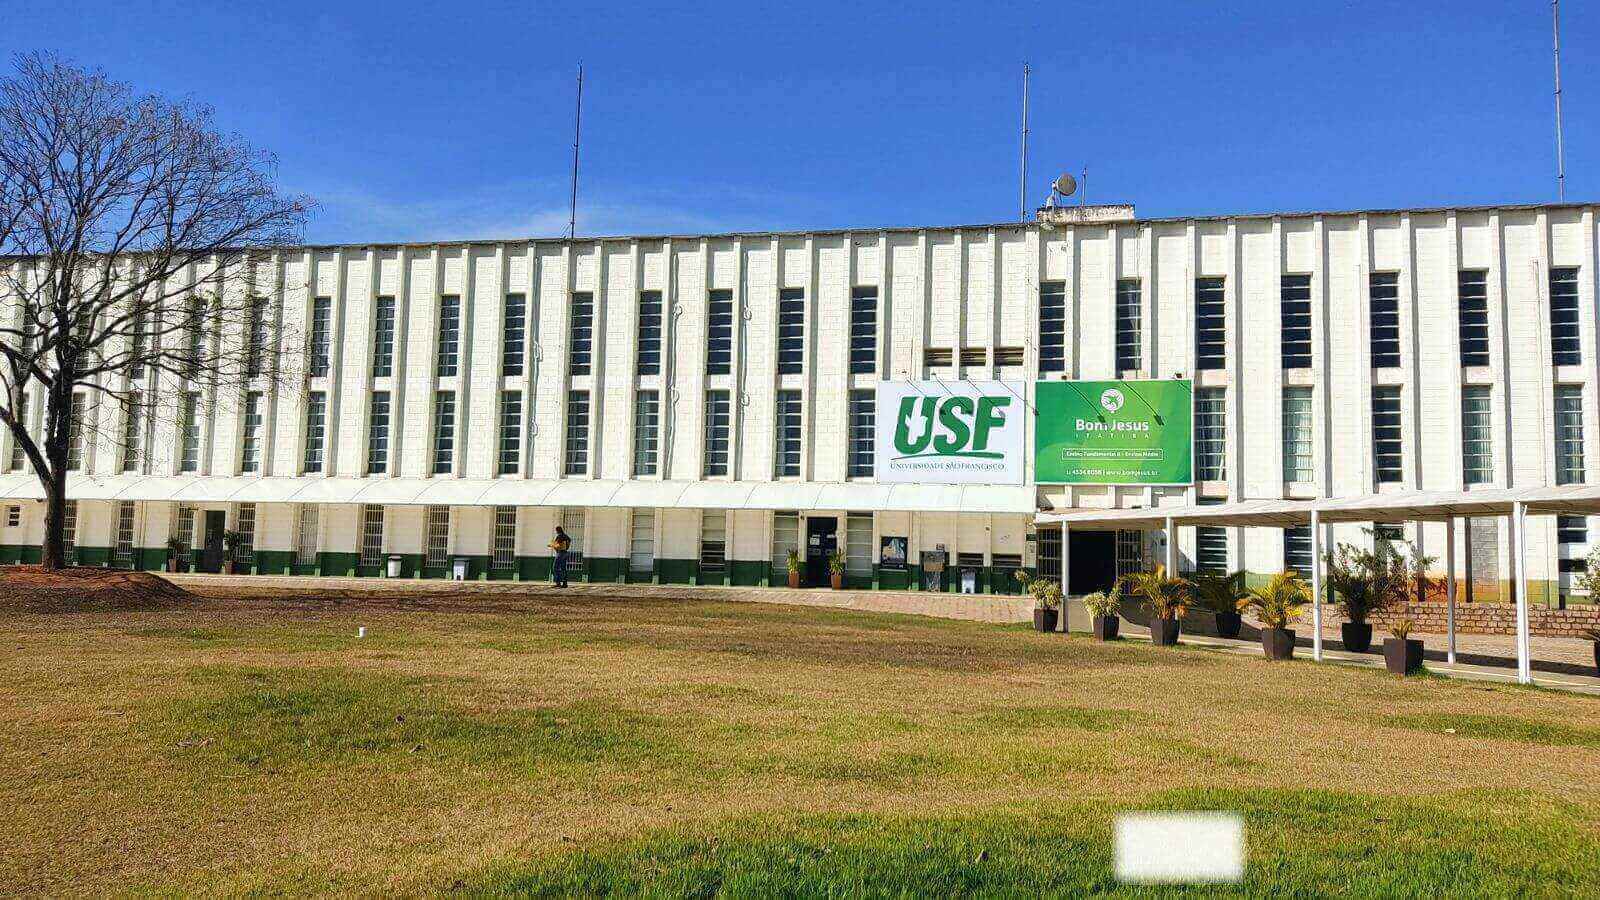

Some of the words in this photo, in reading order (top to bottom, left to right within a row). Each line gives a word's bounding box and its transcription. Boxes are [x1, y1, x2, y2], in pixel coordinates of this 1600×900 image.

[894, 396, 1011, 454] USF
[1075, 419, 1108, 431] Bom
[1110, 419, 1149, 431] Jesus
[945, 461, 961, 470] SÃO
